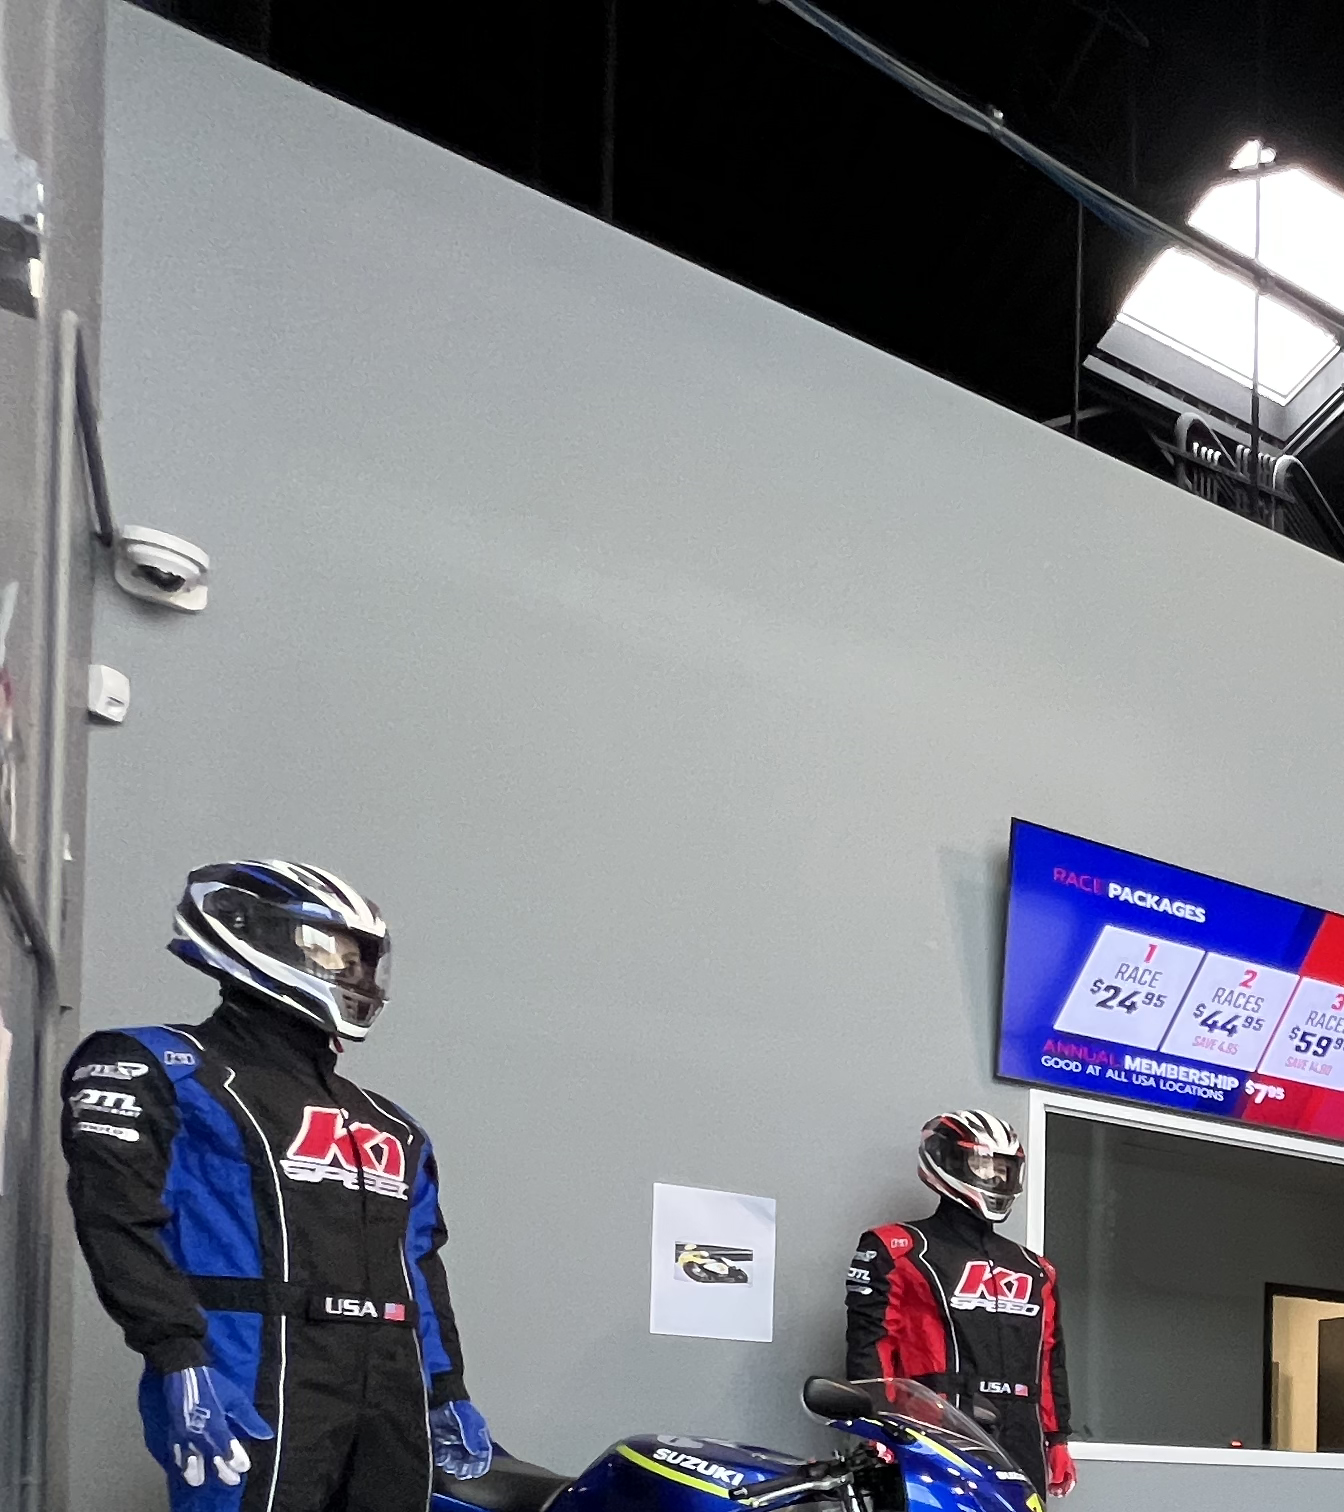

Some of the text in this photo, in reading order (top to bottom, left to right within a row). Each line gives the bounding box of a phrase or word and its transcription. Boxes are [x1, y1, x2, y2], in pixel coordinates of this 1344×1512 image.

[1108, 882, 1206, 924] PACKAGES
[1143, 943, 1158, 963] 1
[1114, 962, 1163, 989] RACE
[1238, 969, 1258, 988] 2
[1211, 986, 1265, 1013] RACES
[1192, 1035, 1218, 1051] SAVE
[1043, 1038, 1120, 1068] ANNUAL
[1124, 1055, 1240, 1091] MEMBERSHIP
[1041, 1055, 1225, 1102] GOOD AT ALL USA LOCATIONS
[286, 1105, 405, 1182] K1
[953, 1259, 1034, 1304] K1
[325, 1297, 379, 1318] USA
[950, 1295, 1041, 1317] SPEED
[979, 1380, 1012, 1394] USA
[652, 1447, 745, 1487] SUZUKI
